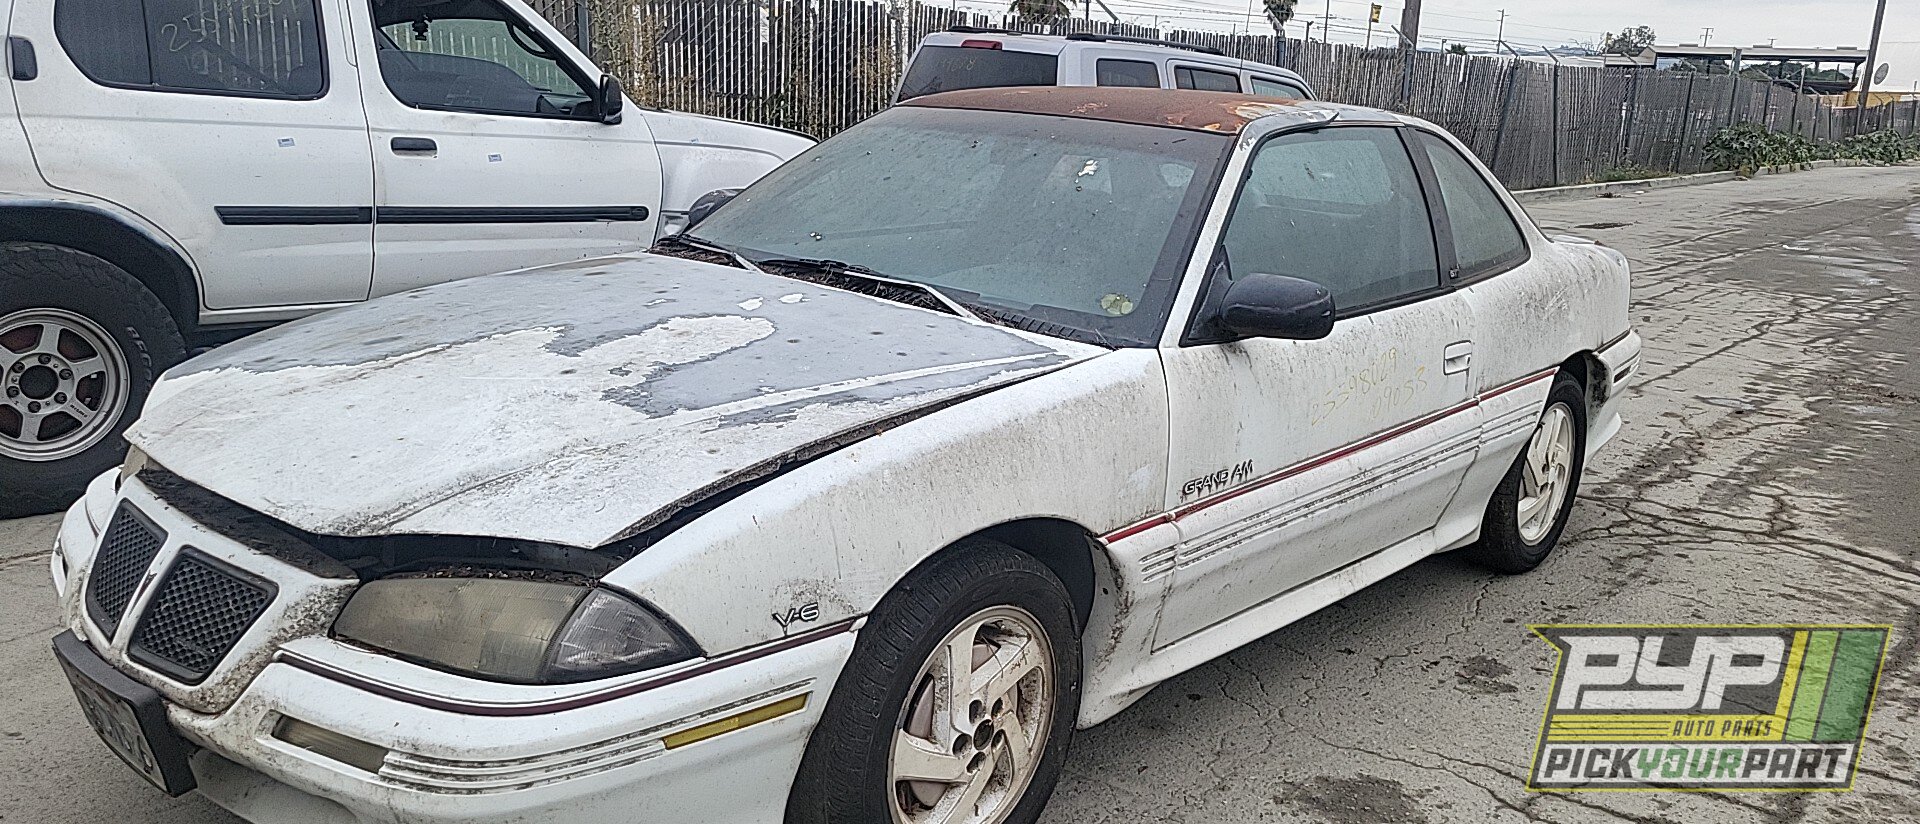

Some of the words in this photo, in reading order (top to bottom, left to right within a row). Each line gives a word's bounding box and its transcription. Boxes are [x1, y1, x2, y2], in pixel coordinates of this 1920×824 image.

[1182, 468, 1229, 495] GRAND
[1230, 459, 1254, 483] AM
[772, 602, 820, 628] V-6
